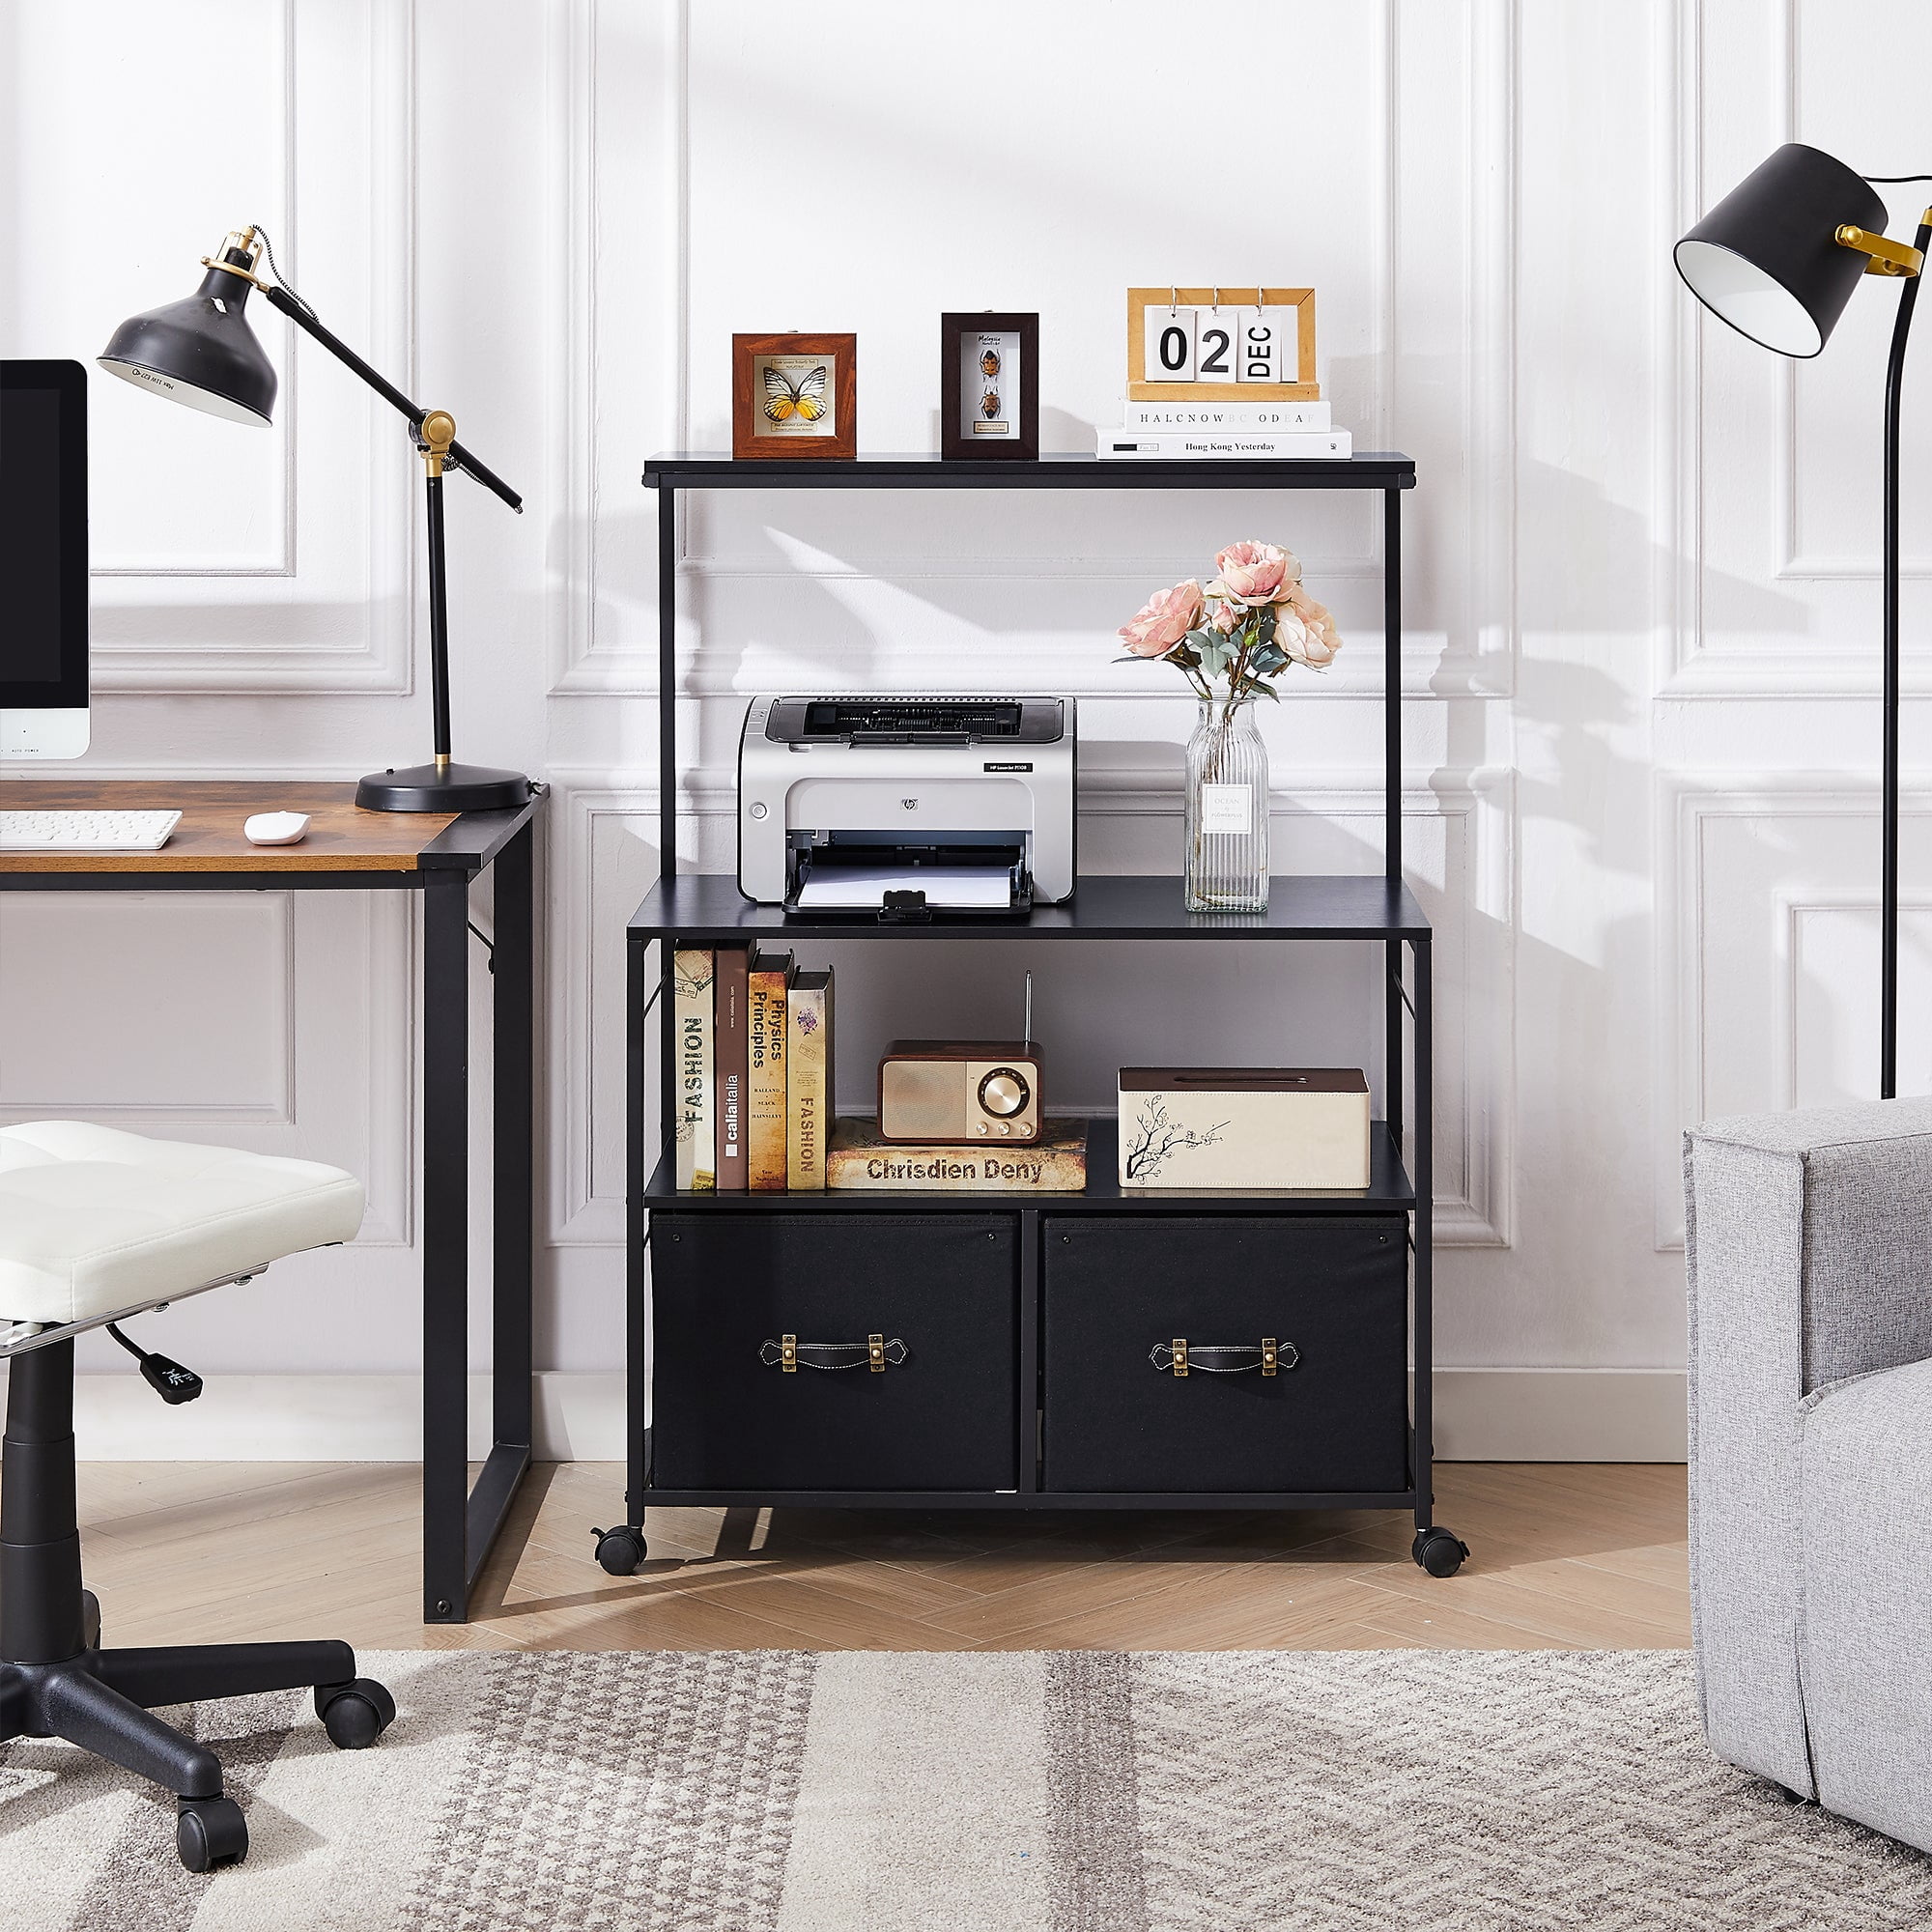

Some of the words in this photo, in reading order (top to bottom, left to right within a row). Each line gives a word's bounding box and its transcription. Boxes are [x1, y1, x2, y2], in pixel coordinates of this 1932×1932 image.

[1247, 327, 1271, 378] DEC
[1185, 442, 1208, 452] Hong
[1210, 442, 1233, 452] Kong
[1235, 442, 1276, 452] Yesterday
[751, 991, 768, 1069] Principles
[768, 999, 785, 1062] Physics
[684, 1017, 703, 1122] FASHION
[724, 1074, 738, 1141] caliaitalia
[800, 1097, 814, 1173] FASHION
[867, 1158, 977, 1179] Chrisdien
[984, 1158, 1043, 1184] Deny
